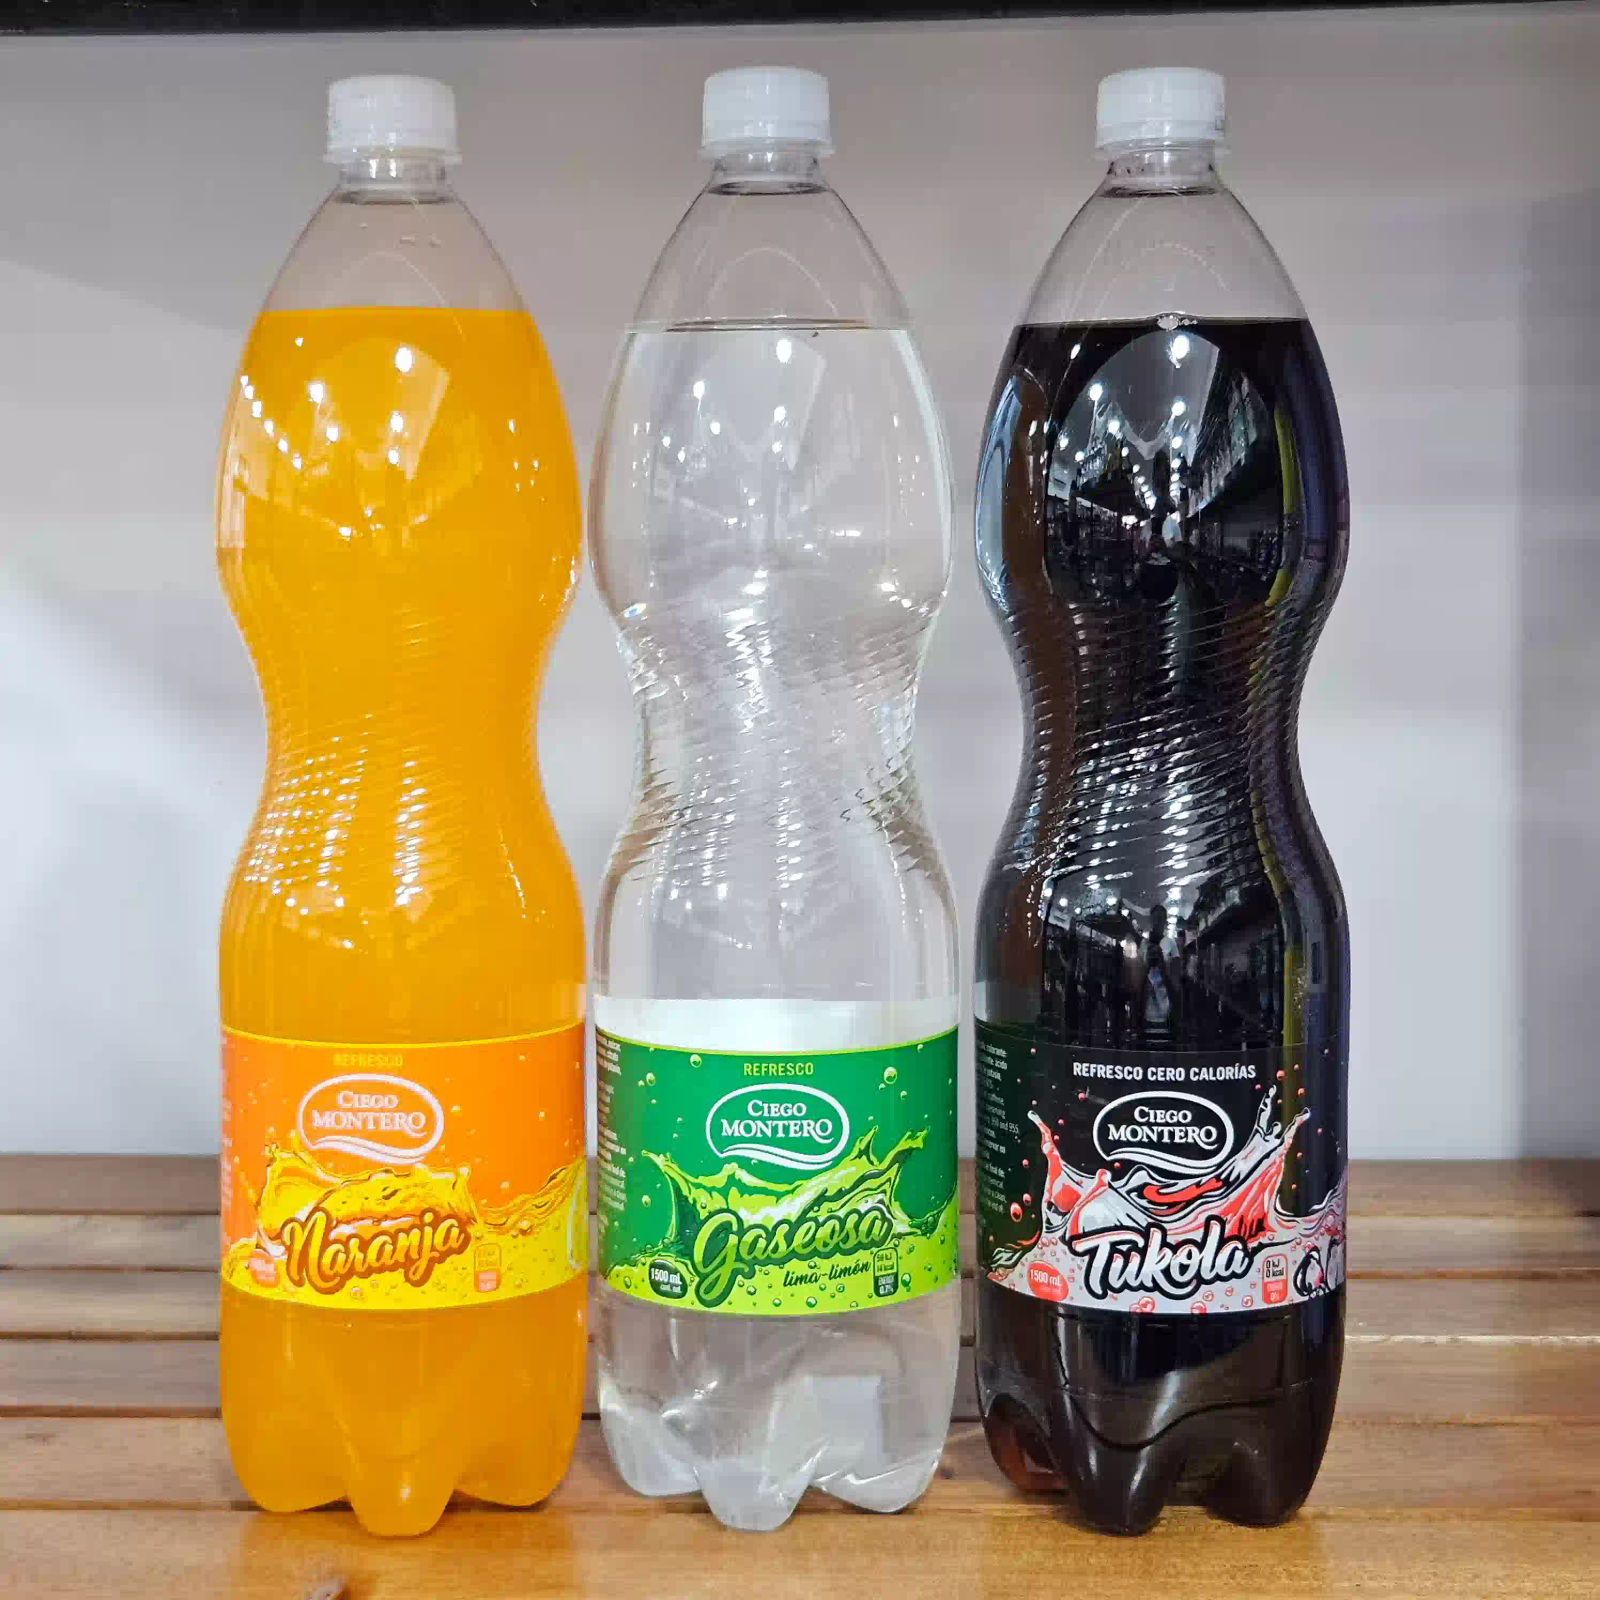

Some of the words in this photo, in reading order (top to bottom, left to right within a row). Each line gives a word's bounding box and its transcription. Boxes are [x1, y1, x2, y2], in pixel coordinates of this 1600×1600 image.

[743, 1062, 814, 1076] REFRESCO
[1073, 1062, 1143, 1080] REFRESCO
[1147, 1067, 1185, 1081] CERO
[1189, 1063, 1256, 1081] CALORÍAS
[337, 1090, 398, 1108] CIEGO
[747, 1099, 807, 1117] CIEGO
[311, 1110, 427, 1137] MONTERO
[1133, 1105, 1193, 1123] CIEGO
[720, 1118, 834, 1144] MONTERO
[1107, 1123, 1218, 1150] MONTERO
[283, 1208, 469, 1292] Naranja
[692, 1208, 890, 1303] Gaseosa
[1069, 1216, 1252, 1298] Tukola
[650, 1267, 669, 1282] 1500
[783, 1259, 871, 1287] lima-limón
[1030, 1269, 1049, 1284] 1500
